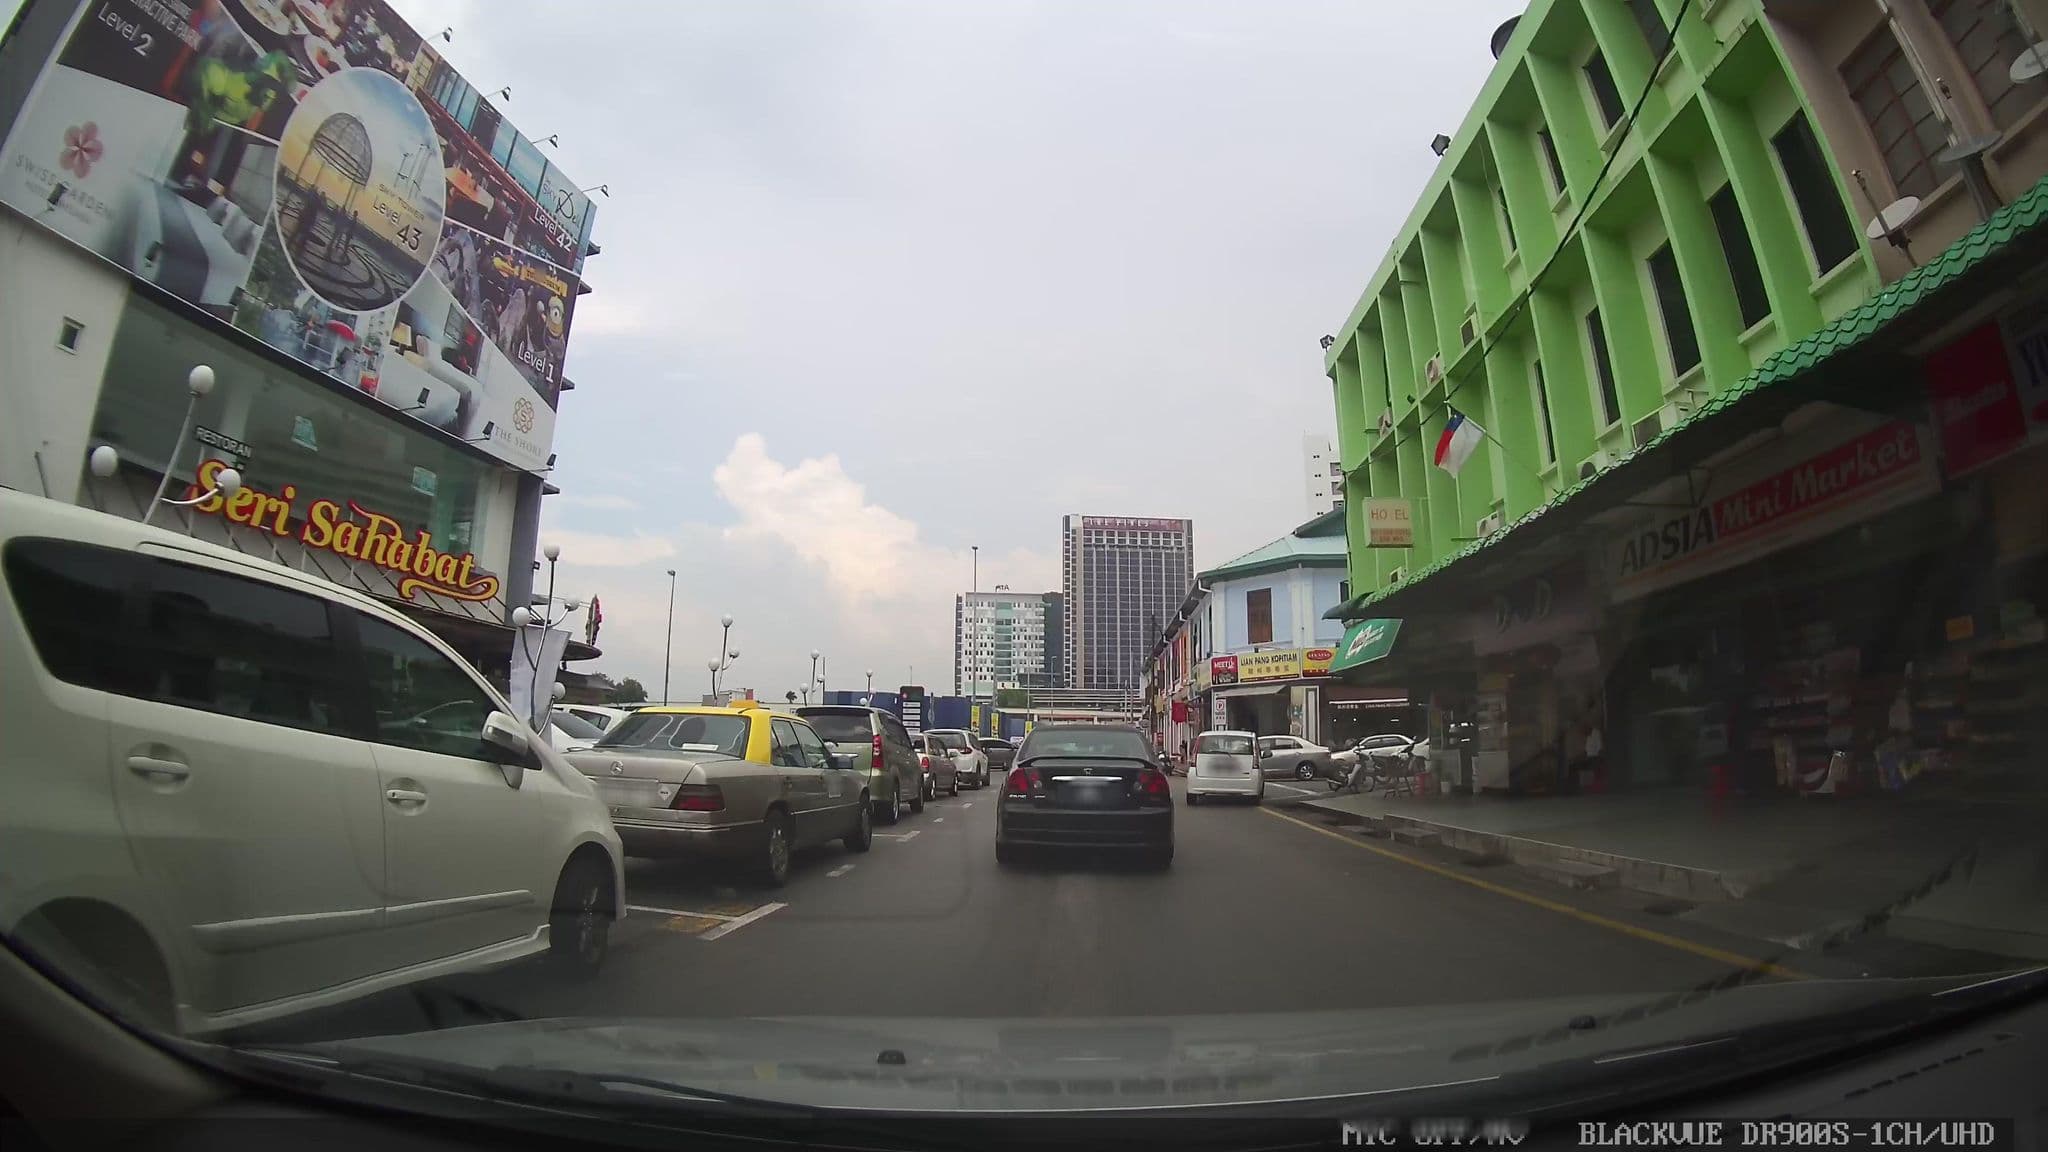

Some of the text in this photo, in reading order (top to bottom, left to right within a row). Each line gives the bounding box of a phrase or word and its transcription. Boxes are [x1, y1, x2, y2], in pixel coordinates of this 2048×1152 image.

[97, 2, 141, 42] Level
[133, 33, 153, 57] 2
[62, 180, 115, 221] ARDEN
[372, 198, 424, 251] Level 43
[534, 207, 558, 236] Level
[556, 233, 573, 253] 42
[517, 340, 554, 383] Level 1
[196, 427, 252, 459] RESTORAN
[1370, 508, 1409, 520] HOEL
[1620, 427, 1915, 577] ADSIA Mini Market
[190, 458, 500, 602] Seri Sahabat
[1255, 655, 1270, 665] PANG
[1271, 653, 1298, 663] KOPITIAM
